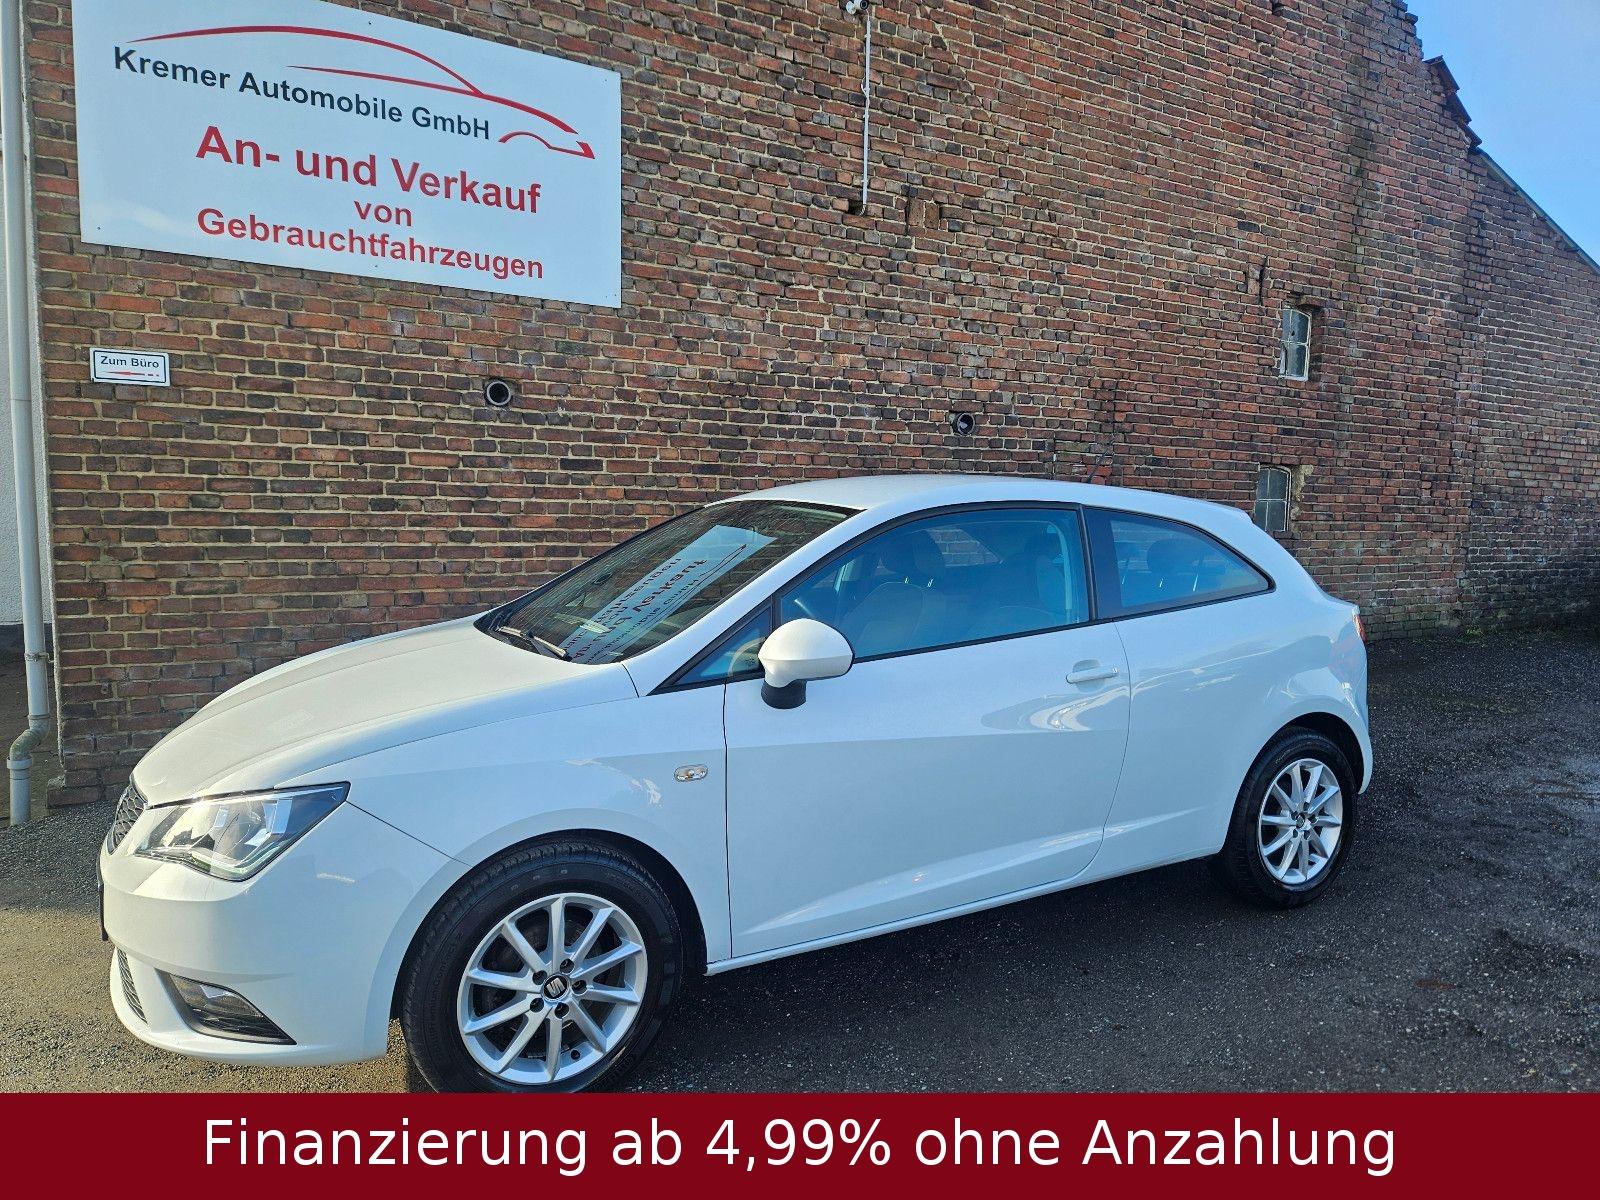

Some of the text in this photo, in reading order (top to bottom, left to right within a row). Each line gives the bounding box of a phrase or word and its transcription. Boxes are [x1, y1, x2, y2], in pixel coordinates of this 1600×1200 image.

[114, 46, 491, 141] Kremer Automobile GmbH
[196, 126, 541, 214] An- und Verkauf
[197, 208, 544, 279] Gebrauchtfahrzeugen
[354, 200, 412, 226] von
[100, 355, 160, 369] Zum Büro
